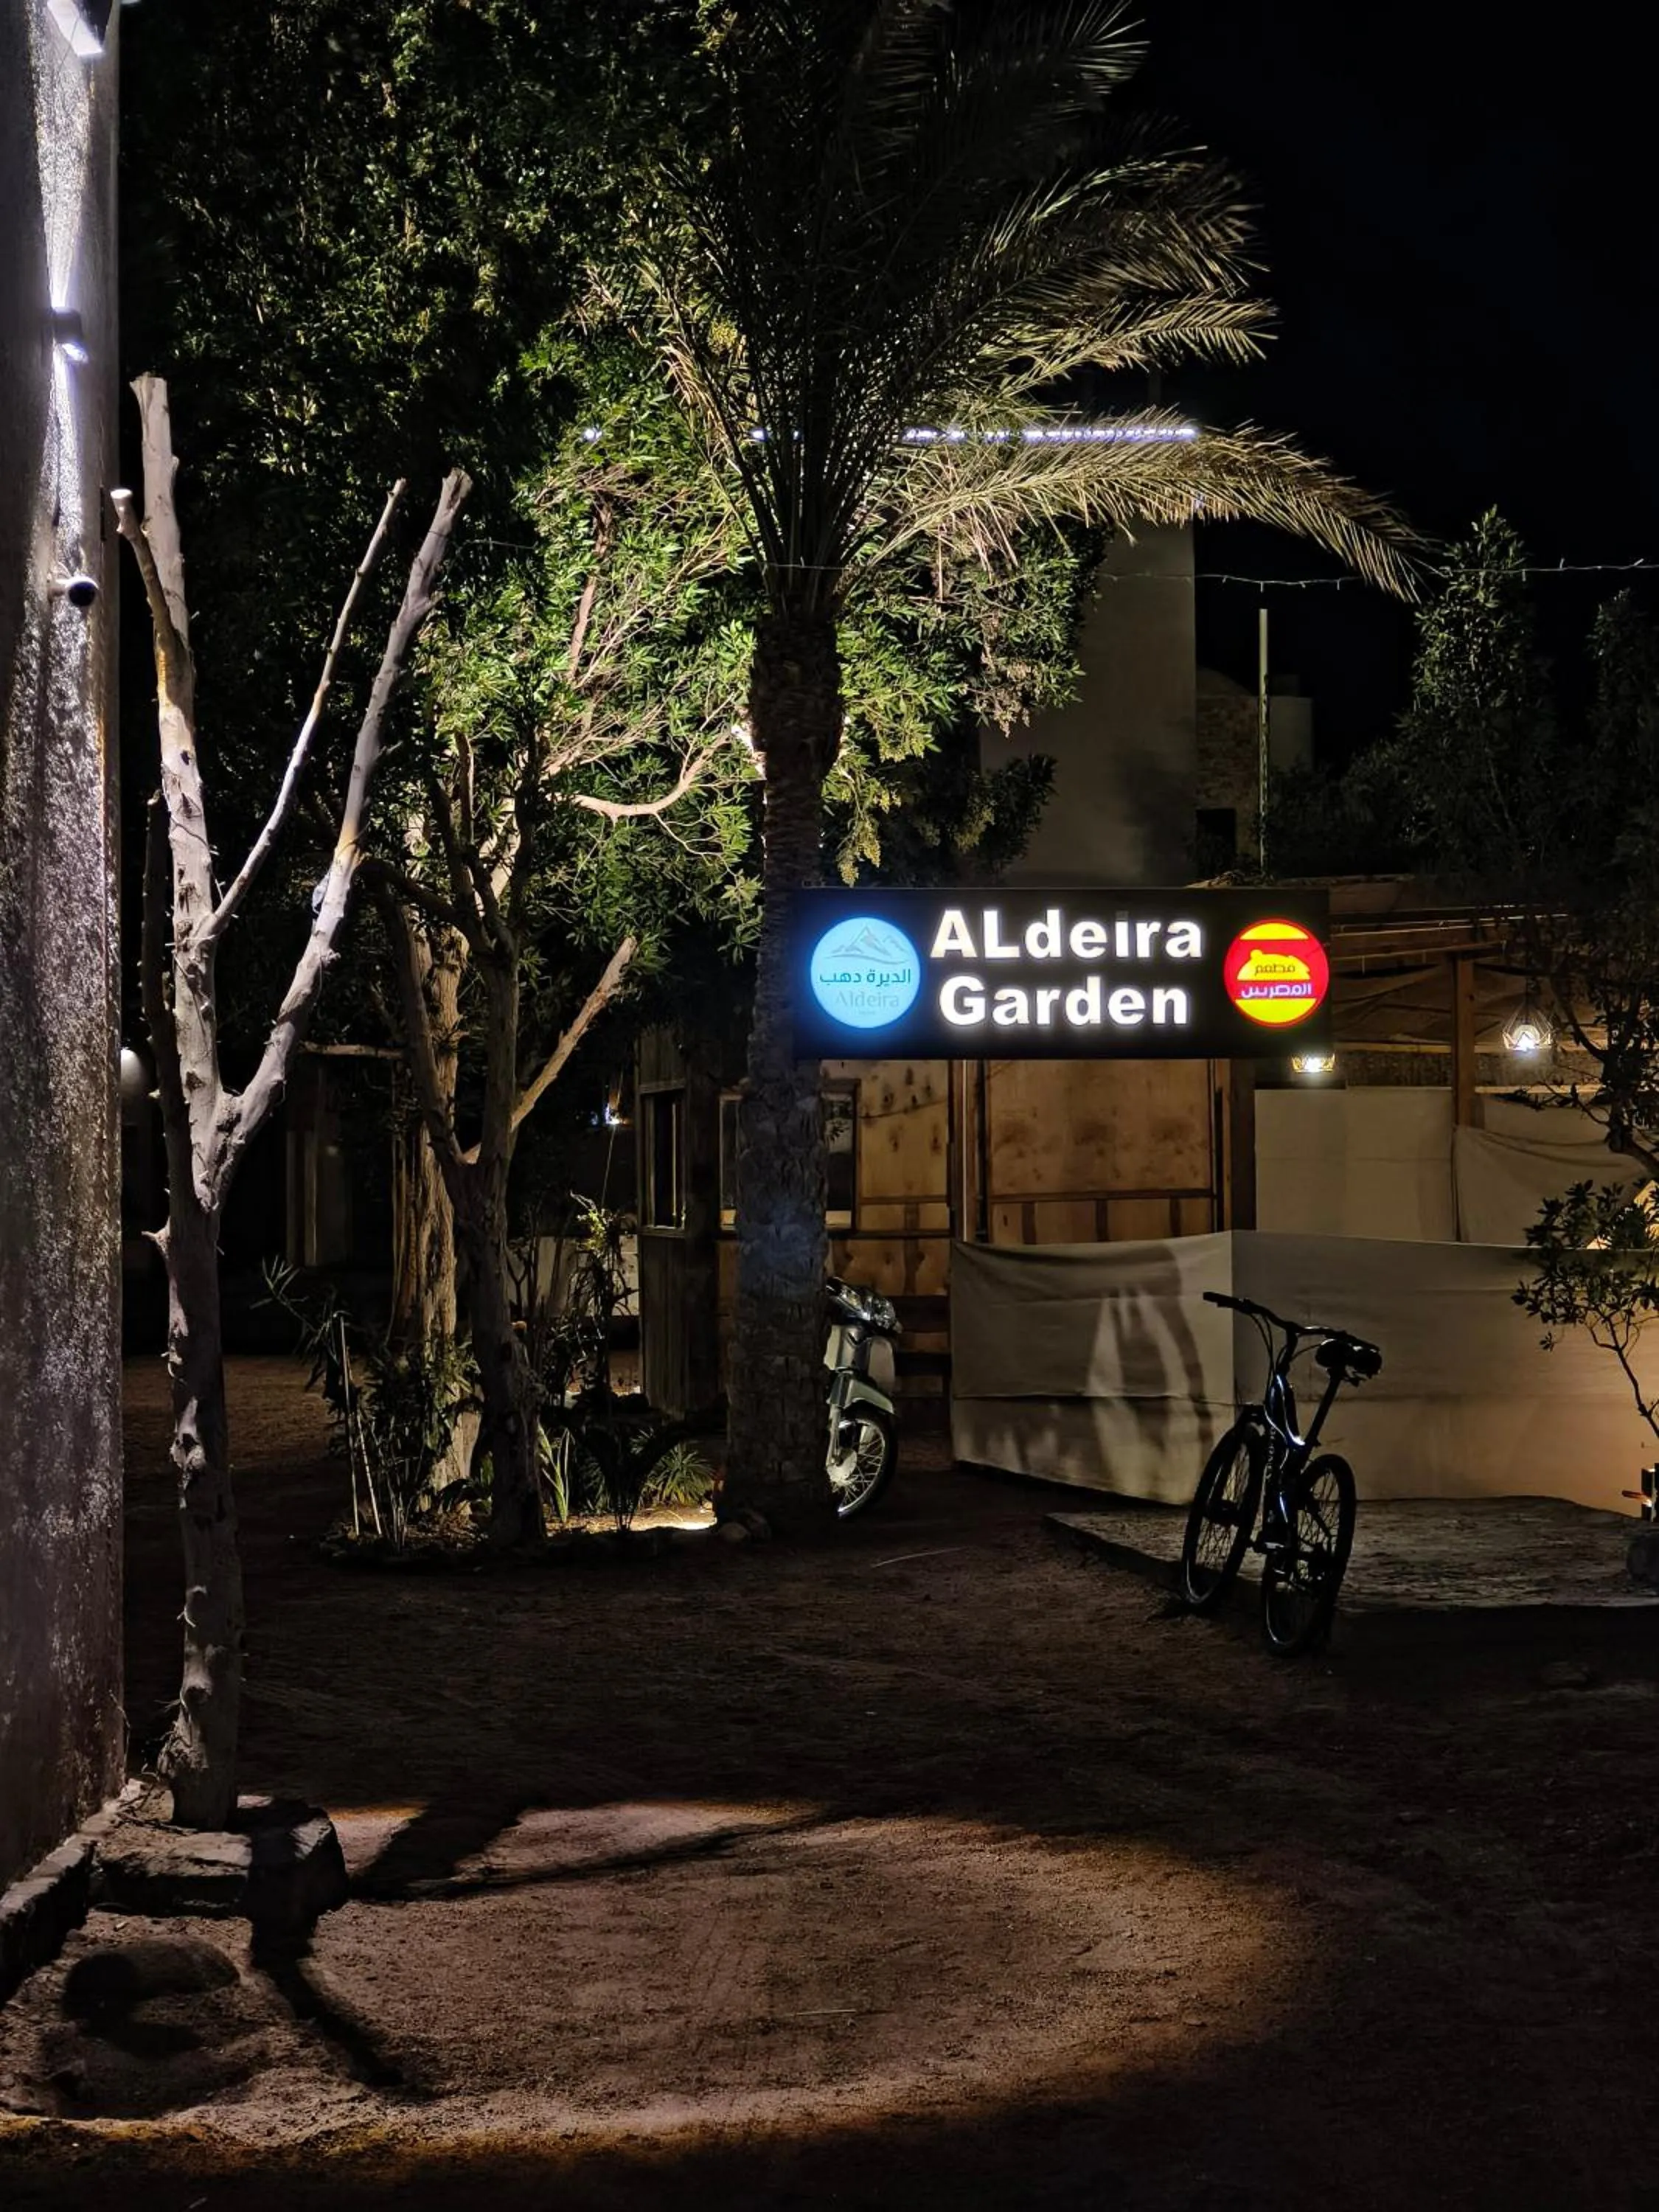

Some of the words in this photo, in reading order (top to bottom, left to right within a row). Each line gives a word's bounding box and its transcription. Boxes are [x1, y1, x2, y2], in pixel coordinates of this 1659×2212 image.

[929, 908, 1203, 959] ALdeira
[819, 972, 862, 986] دهب
[866, 968, 911, 987] الديرة
[1254, 963, 1295, 977] مطعم
[835, 990, 900, 1008] Aldeira
[939, 975, 1188, 1026] Garden
